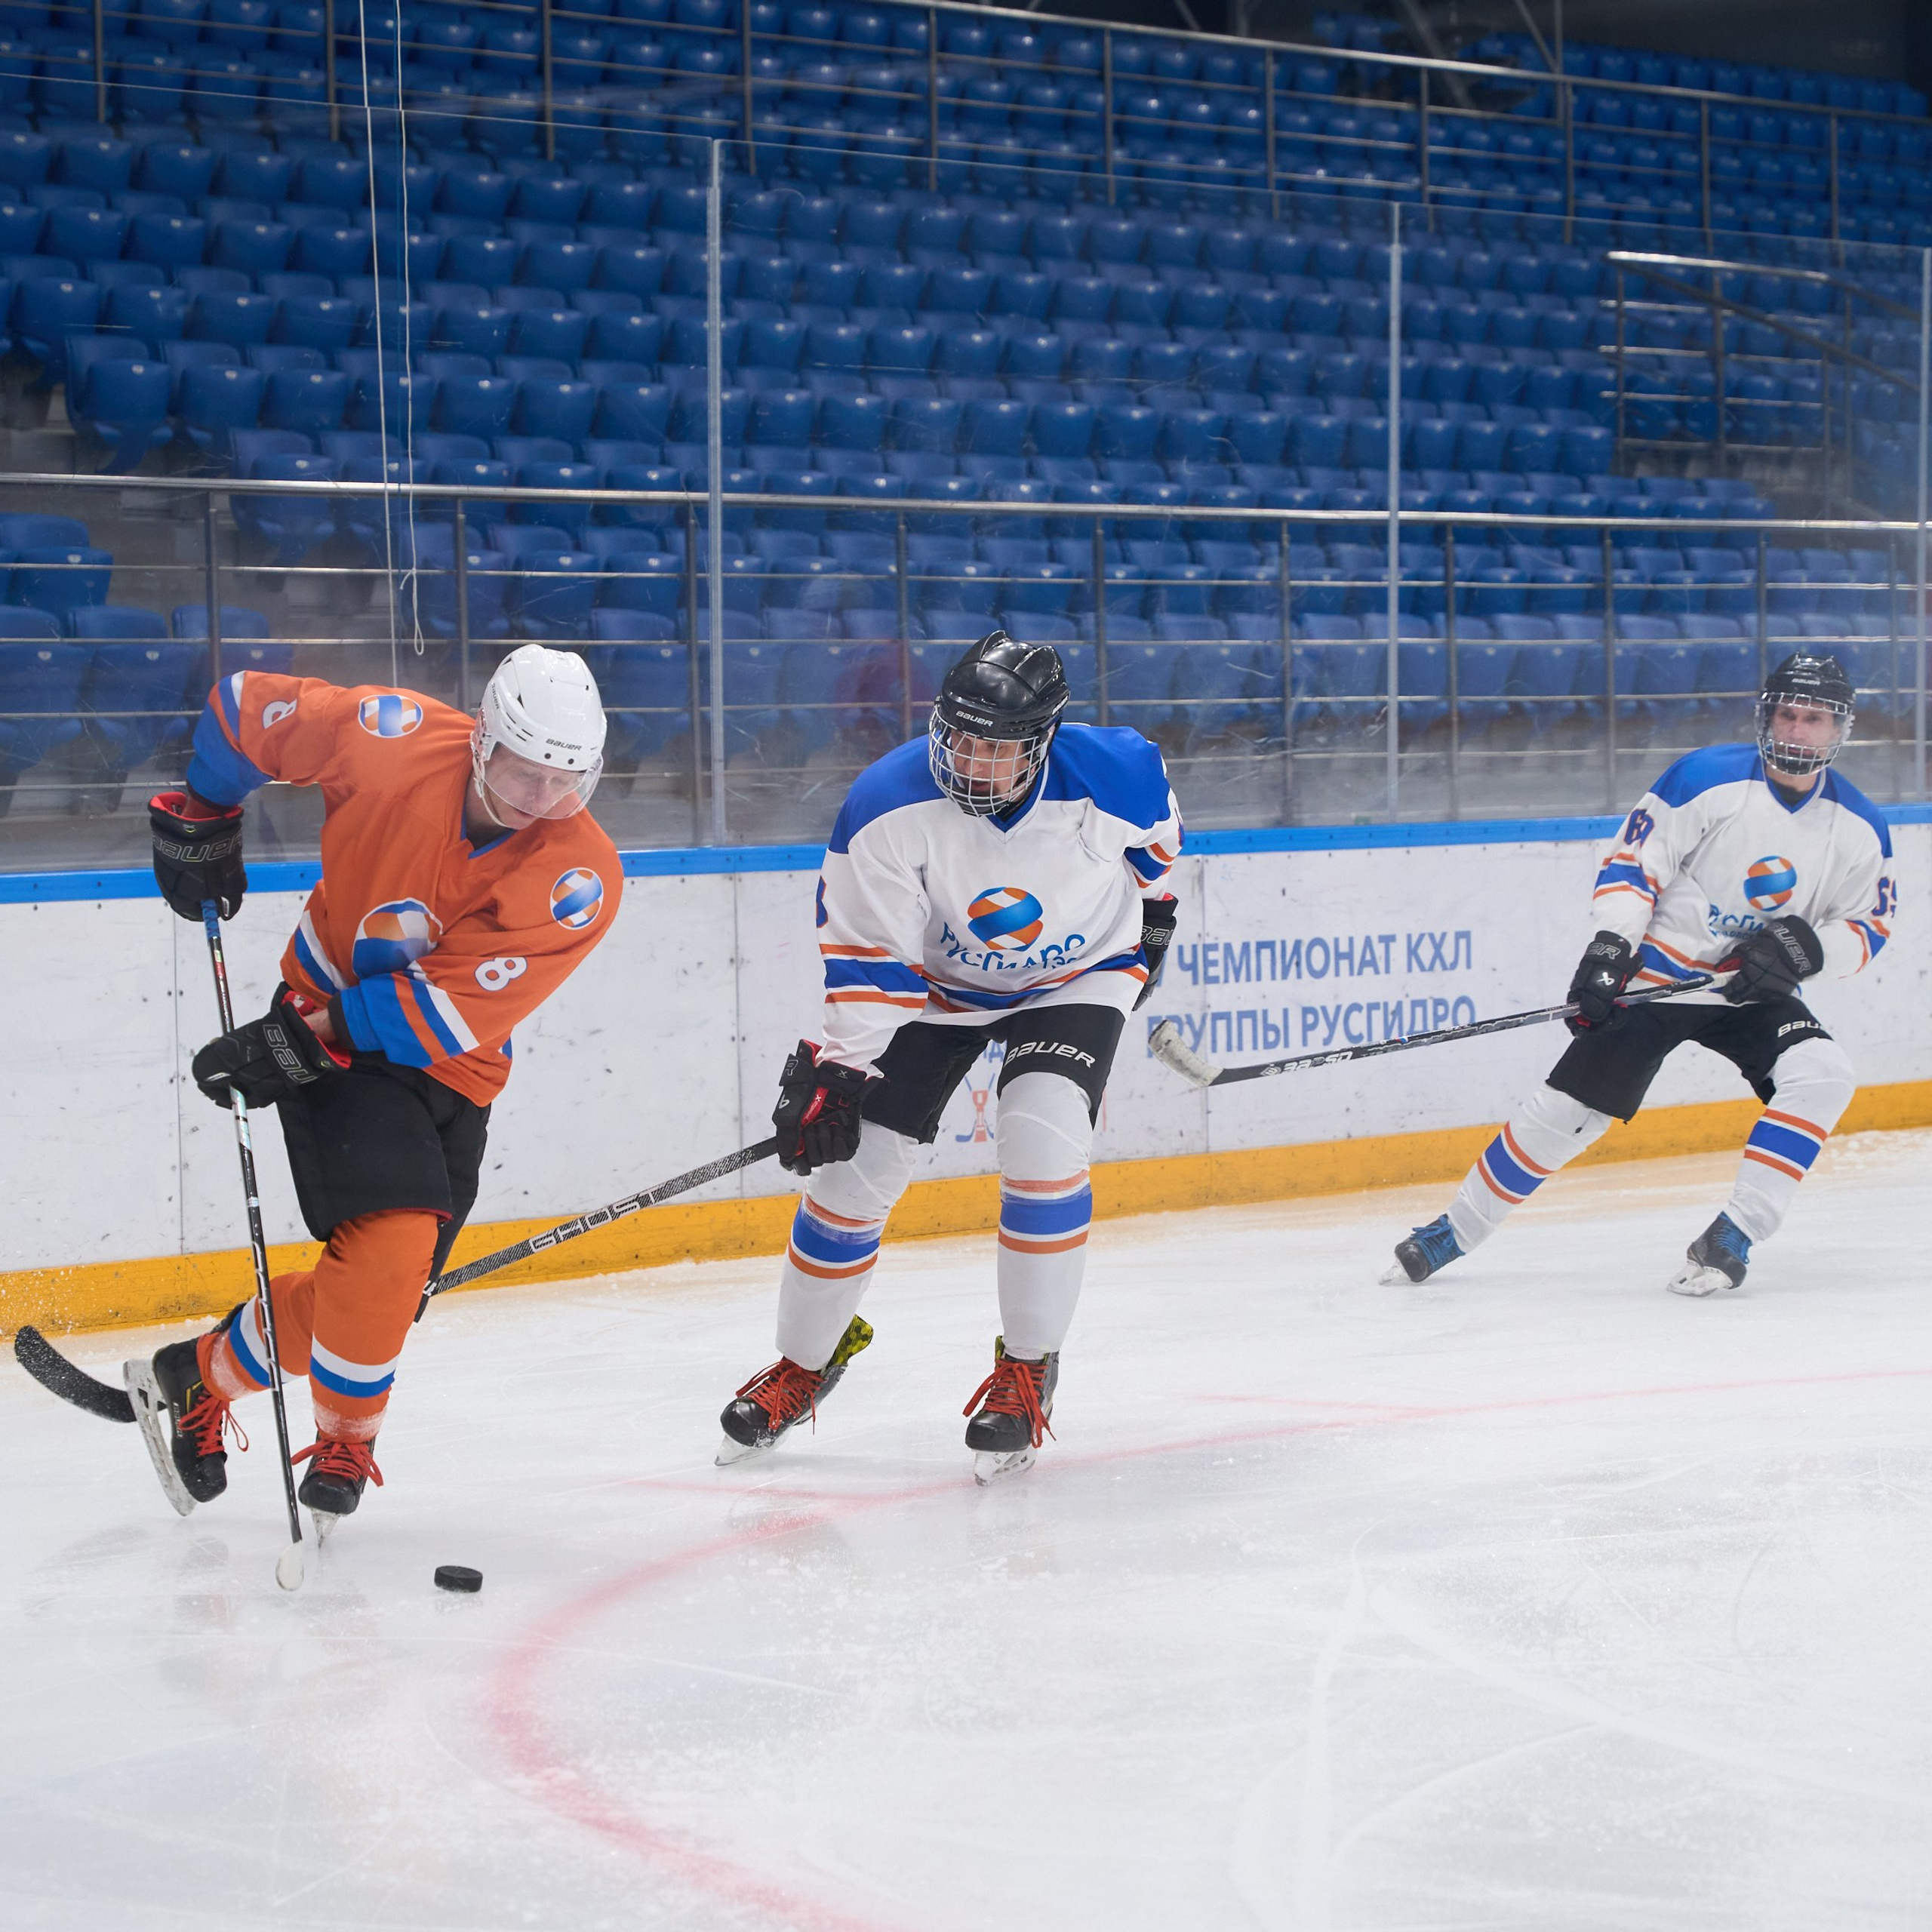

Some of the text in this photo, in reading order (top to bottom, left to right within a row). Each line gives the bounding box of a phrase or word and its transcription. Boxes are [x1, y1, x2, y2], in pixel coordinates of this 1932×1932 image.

[955, 710, 994, 728] BAUER
[546, 738, 582, 751] BAUER
[473, 956, 528, 992] 8
[1177, 934, 1397, 986] ЧЕМПИОНАТ
[1406, 930, 1472, 974] КХЛ
[1300, 995, 1476, 1048] РУСГИДРО
[1777, 1020, 1826, 1038] BAU
[263, 1024, 318, 1084] BAU
[1003, 1041, 1096, 1069] BAUER
[528, 1180, 669, 1254] GHOST
